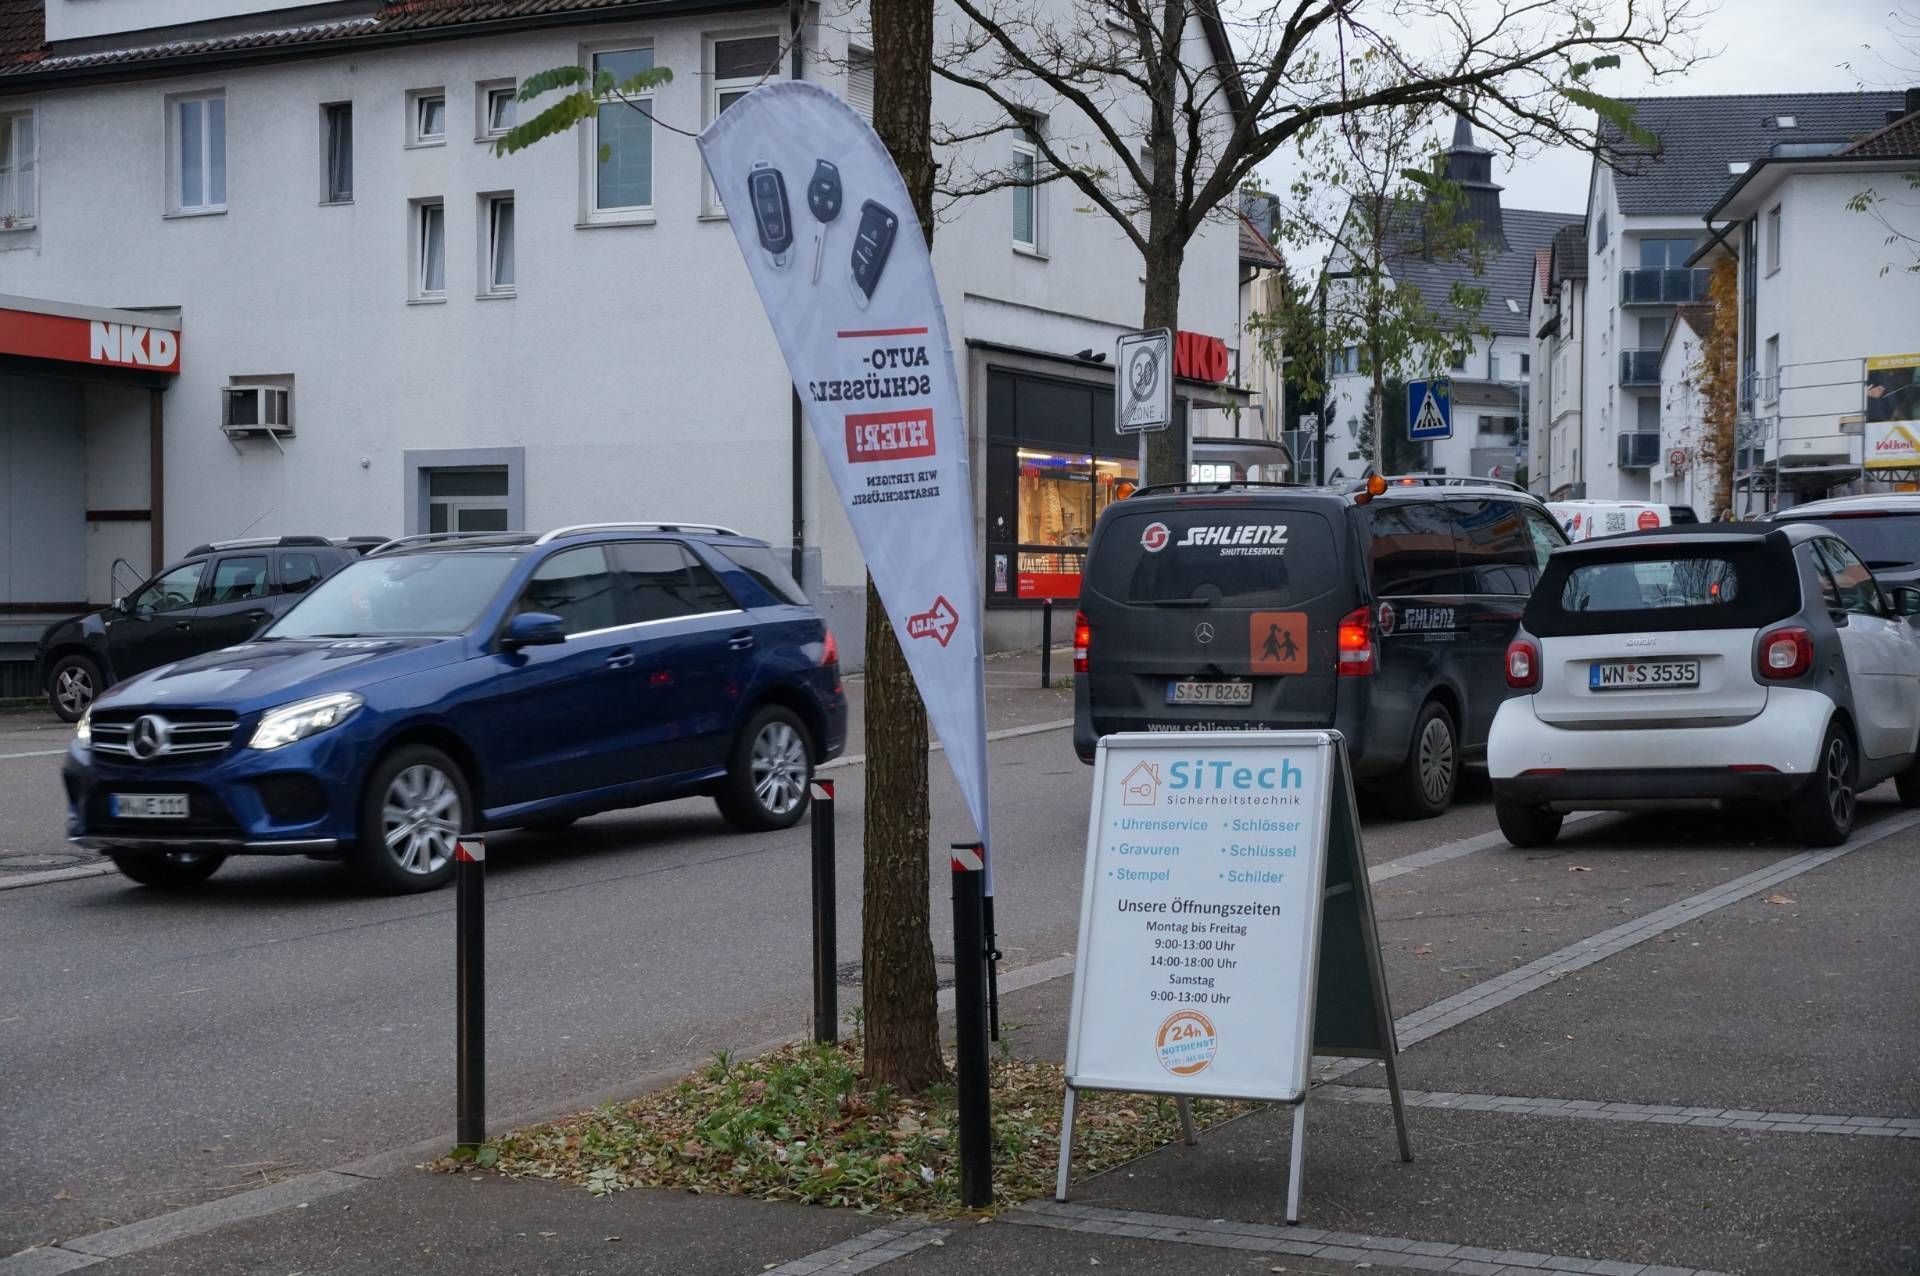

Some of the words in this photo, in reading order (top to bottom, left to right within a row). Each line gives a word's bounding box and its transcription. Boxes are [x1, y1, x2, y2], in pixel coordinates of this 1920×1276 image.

[90, 320, 177, 367] NKD
[1174, 330, 1229, 382] NKD
[1135, 360, 1154, 386] 30
[1131, 404, 1155, 421] ZONE
[1219, 547, 1285, 556] SHUTTLESERVICE
[1602, 666, 1625, 684] WN
[1636, 665, 1647, 682] S
[1651, 664, 1695, 682] 3535
[1176, 684, 1185, 699] S
[1194, 685, 1213, 699] ST
[1216, 685, 1250, 700] 8263
[1147, 722, 1272, 732] wwwschlienzinfo
[1169, 758, 1302, 790] SiTech
[1167, 795, 1300, 806] Sicherheitstechnik
[1121, 818, 1208, 831] Uhrenservice
[1232, 819, 1301, 832] Schlösser
[1119, 843, 1180, 856] Gravuren
[1229, 844, 1297, 857] Schlüssel
[1116, 867, 1170, 882] Stempel
[1227, 870, 1284, 884] Schilder
[1118, 899, 1167, 913] Unsere
[1171, 897, 1281, 917] Öffnungszeiten
[1146, 921, 1188, 934] Montag
[1191, 922, 1207, 933] bis
[1209, 923, 1247, 936] Freitag
[1154, 938, 1212, 950] 9:00-13:00
[1215, 940, 1235, 951] Uhr
[1150, 955, 1214, 968] 14:00-18:00
[1217, 958, 1237, 969] Uhr
[1169, 974, 1215, 987] Samstag
[1150, 990, 1208, 1003] 9:00-13:00
[1211, 993, 1231, 1004] Uhr
[1171, 1023, 1201, 1041] 24h
[1161, 1039, 1214, 1056] NOTDIENST
